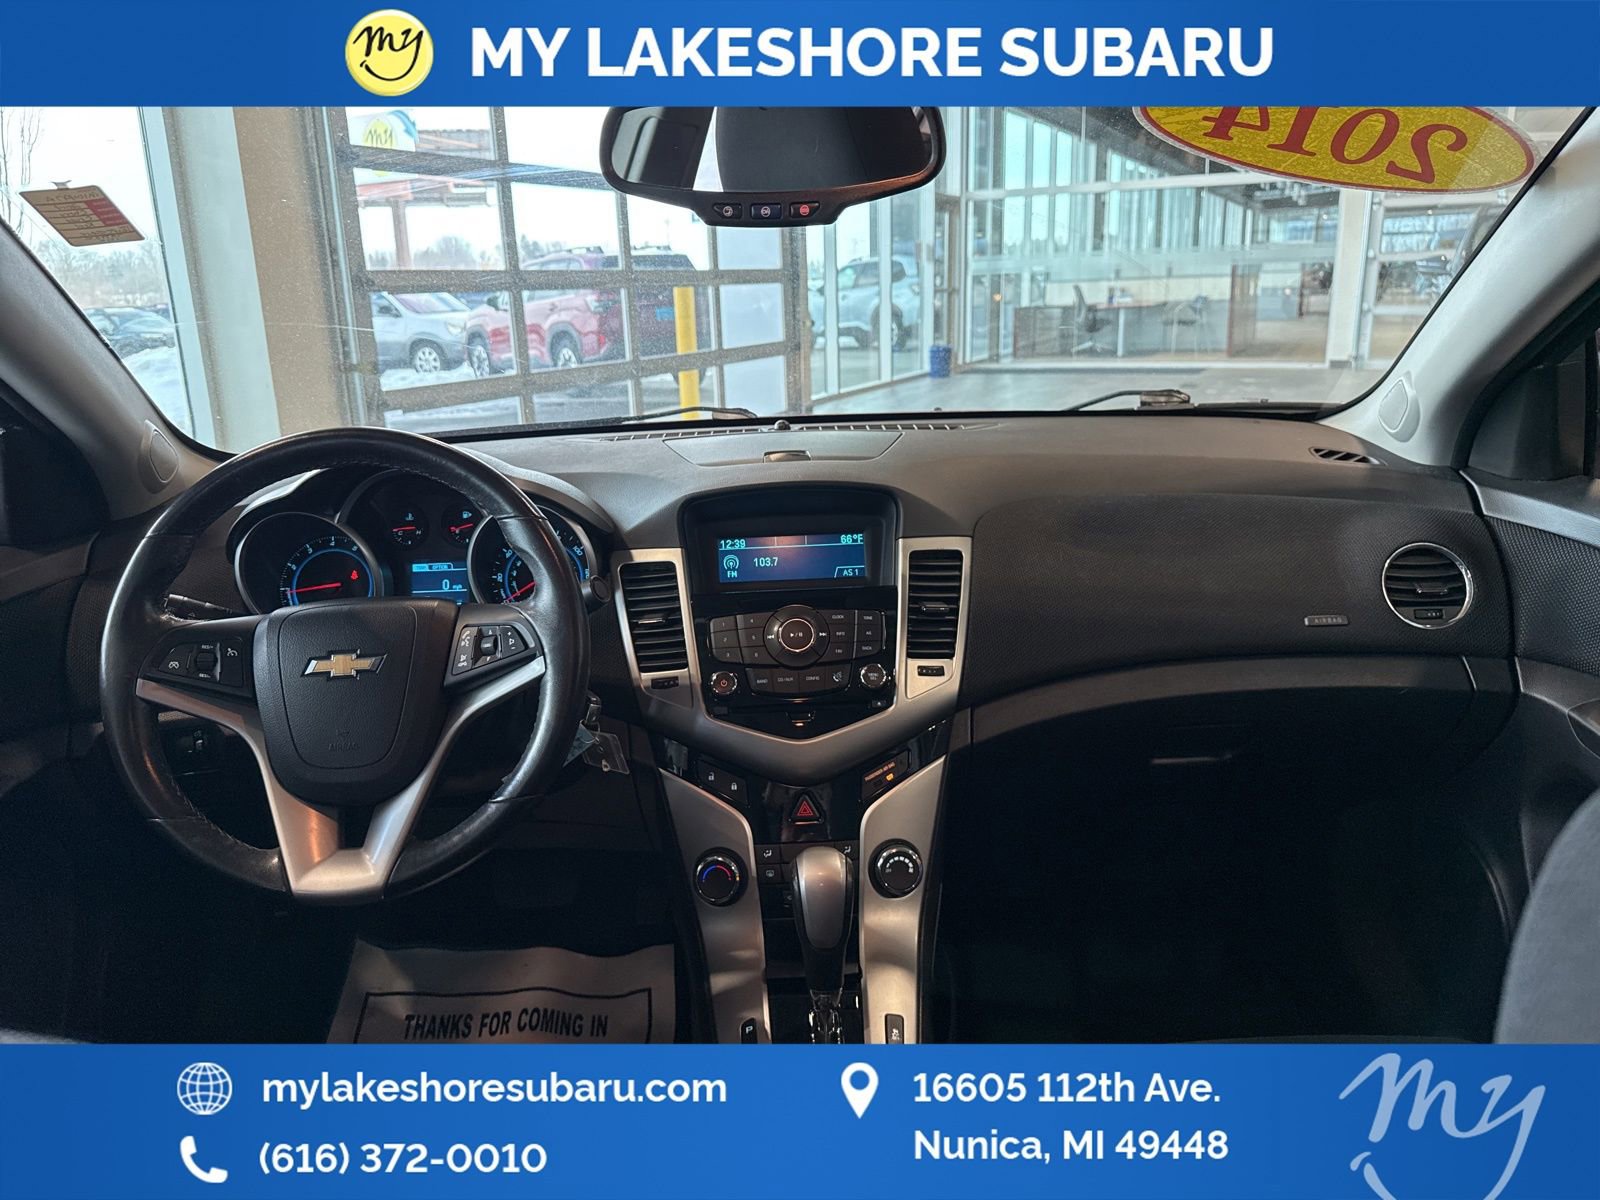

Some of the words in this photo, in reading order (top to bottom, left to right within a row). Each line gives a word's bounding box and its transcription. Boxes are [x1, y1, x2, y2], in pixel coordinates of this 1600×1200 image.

[719, 539, 746, 550] 12:39
[840, 534, 864, 544] 66°F
[753, 556, 779, 567] 103.7
[727, 570, 738, 578] FM
[842, 568, 853, 577] AS
[854, 568, 859, 576] 1
[442, 579, 450, 591] 0
[403, 1013, 473, 1040] THANKS
[478, 1010, 512, 1037] FOR
[517, 1007, 584, 1037] COMING
[590, 1015, 608, 1037] IN
